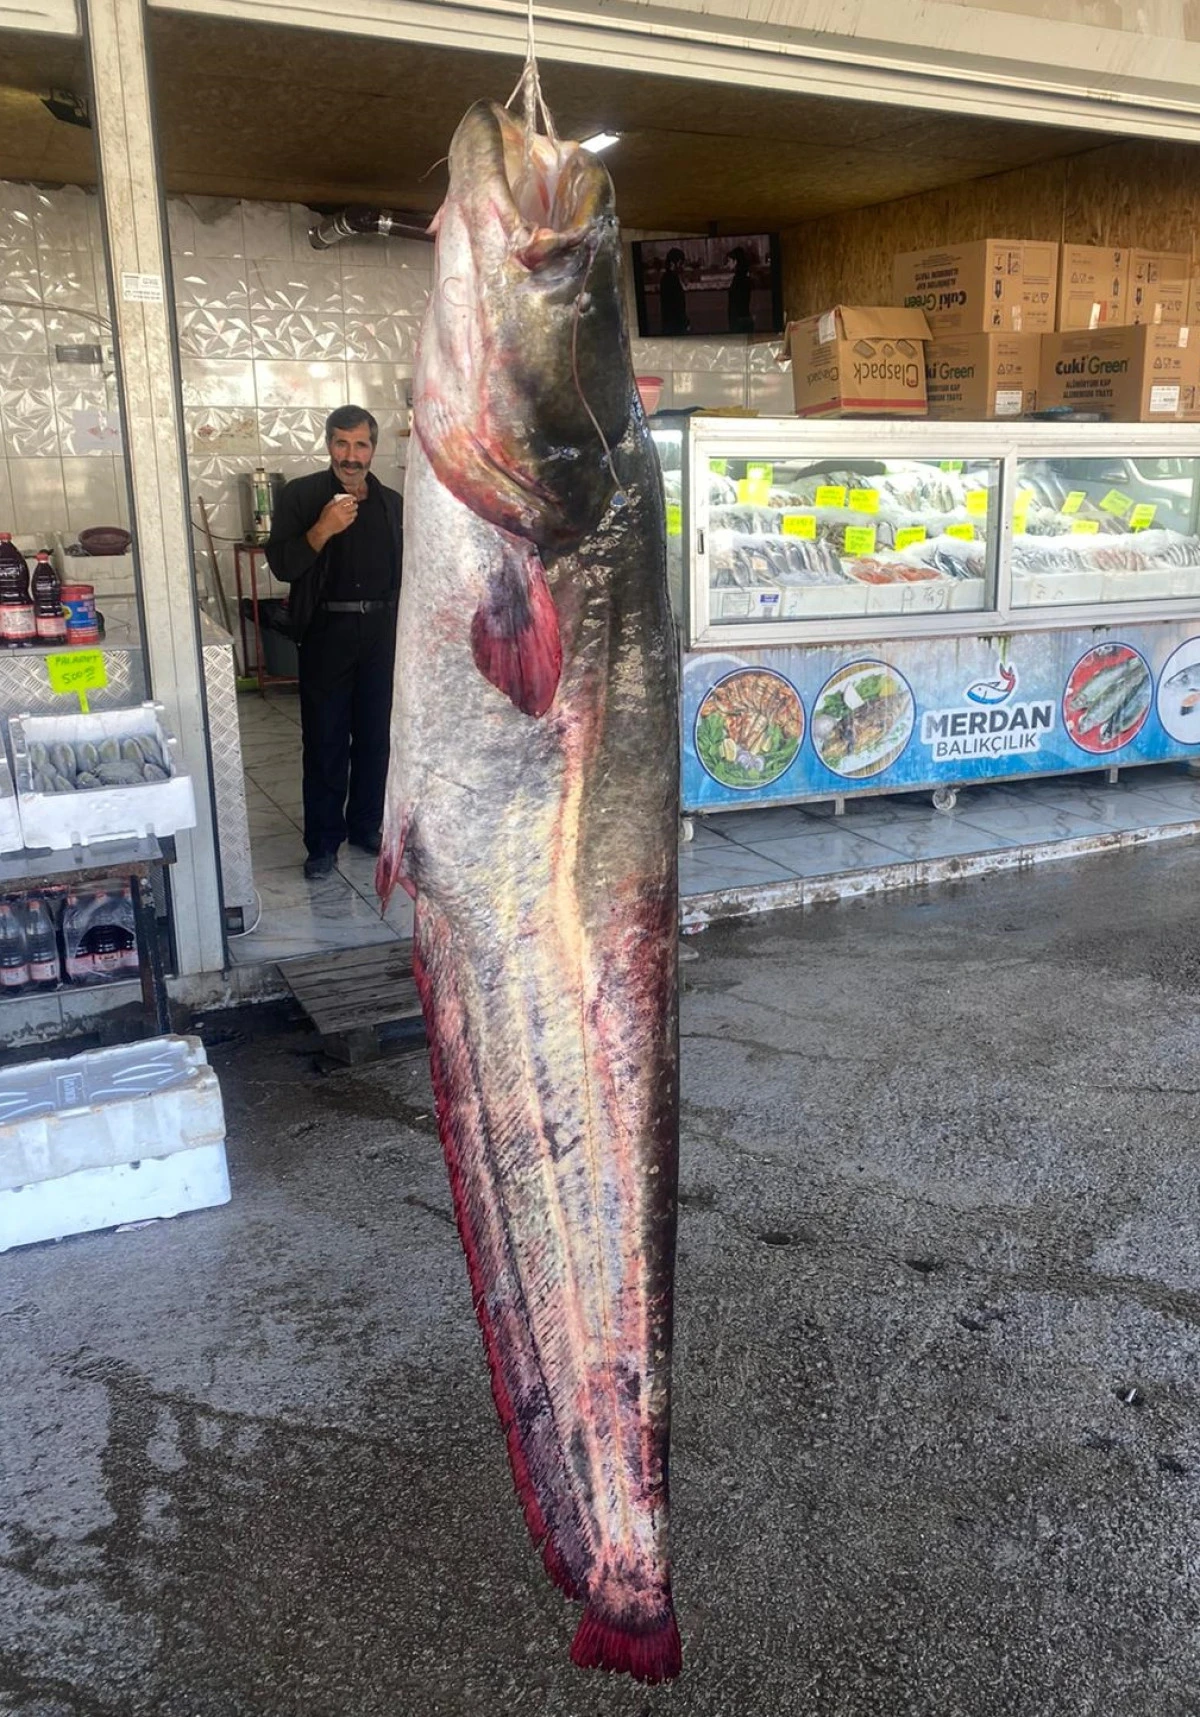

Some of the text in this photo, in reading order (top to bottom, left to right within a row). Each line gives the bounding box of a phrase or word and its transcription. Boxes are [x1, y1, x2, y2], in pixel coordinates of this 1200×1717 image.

[853, 359, 919, 388] Claspack
[939, 361, 975, 380] Green
[1055, 355, 1128, 375] Cuki Green
[925, 705, 1052, 739] MERDAN
[936, 732, 1037, 757] BALIKÇILIK
